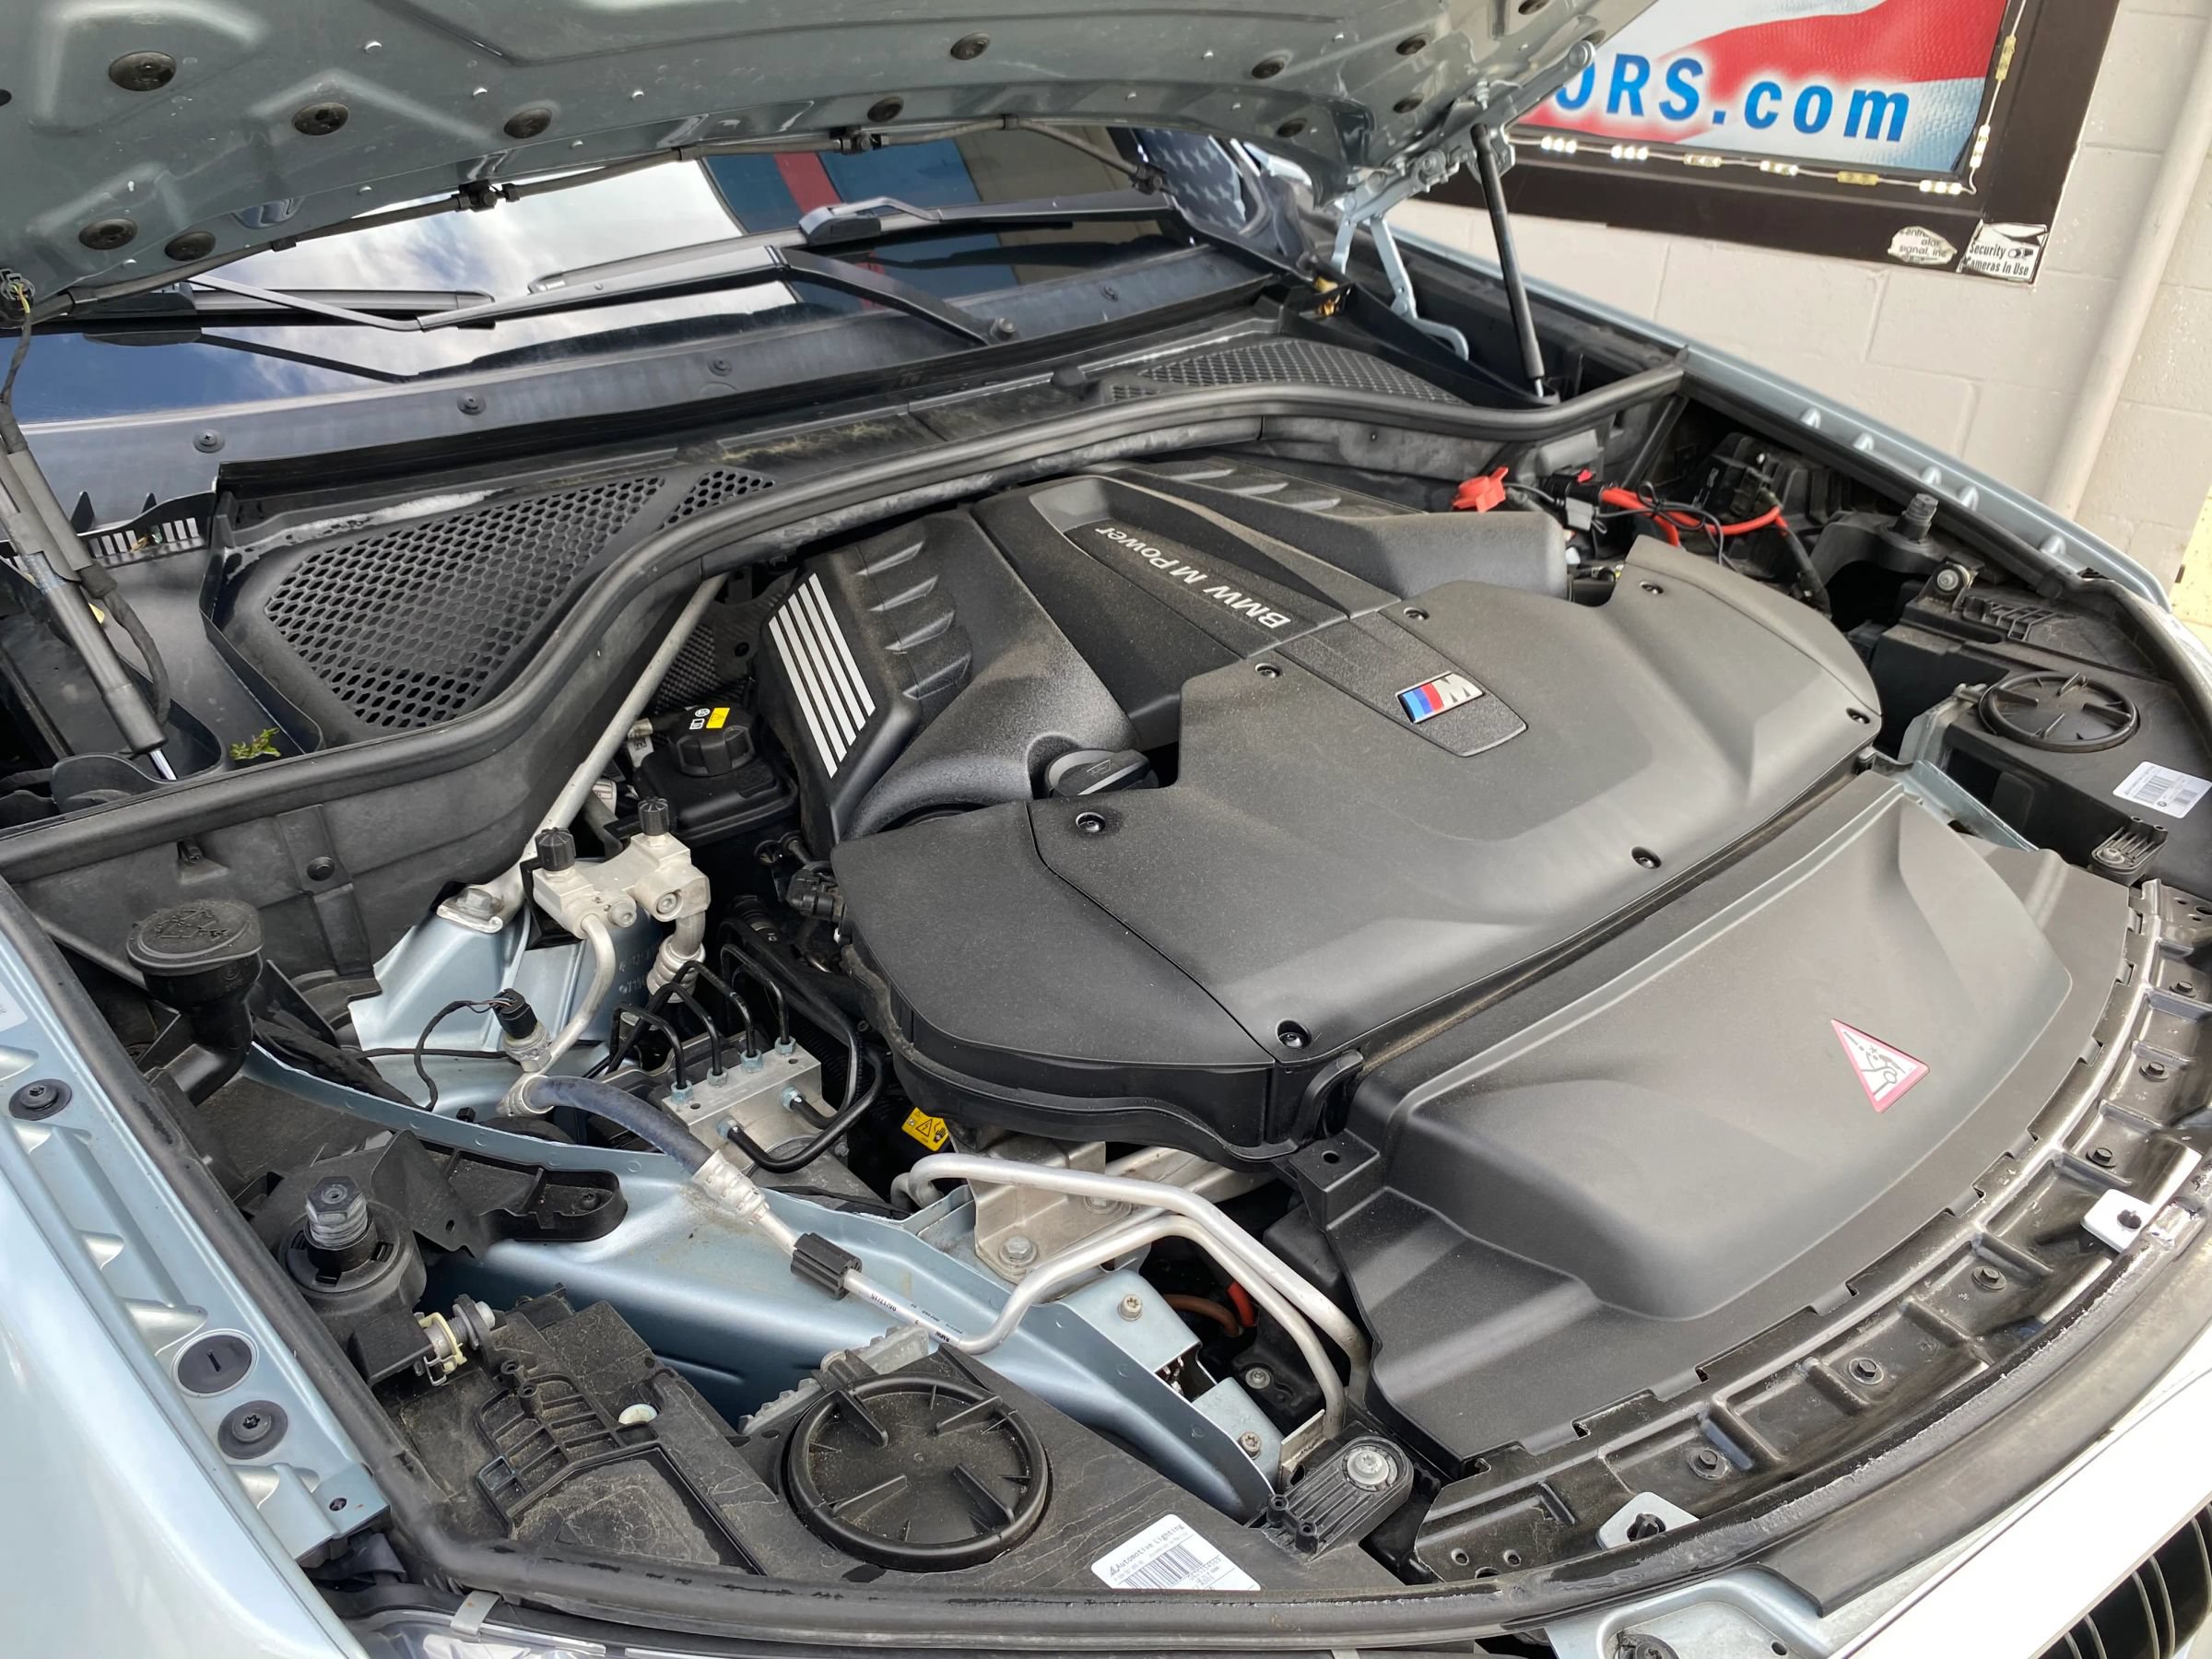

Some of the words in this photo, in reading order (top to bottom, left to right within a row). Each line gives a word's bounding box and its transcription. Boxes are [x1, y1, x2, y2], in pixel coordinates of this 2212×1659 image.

[1969, 243, 2006, 260] Security
[2002, 261, 2012, 274] In
[2013, 262, 2030, 276] Use
[1203, 584, 1291, 629] BMW
